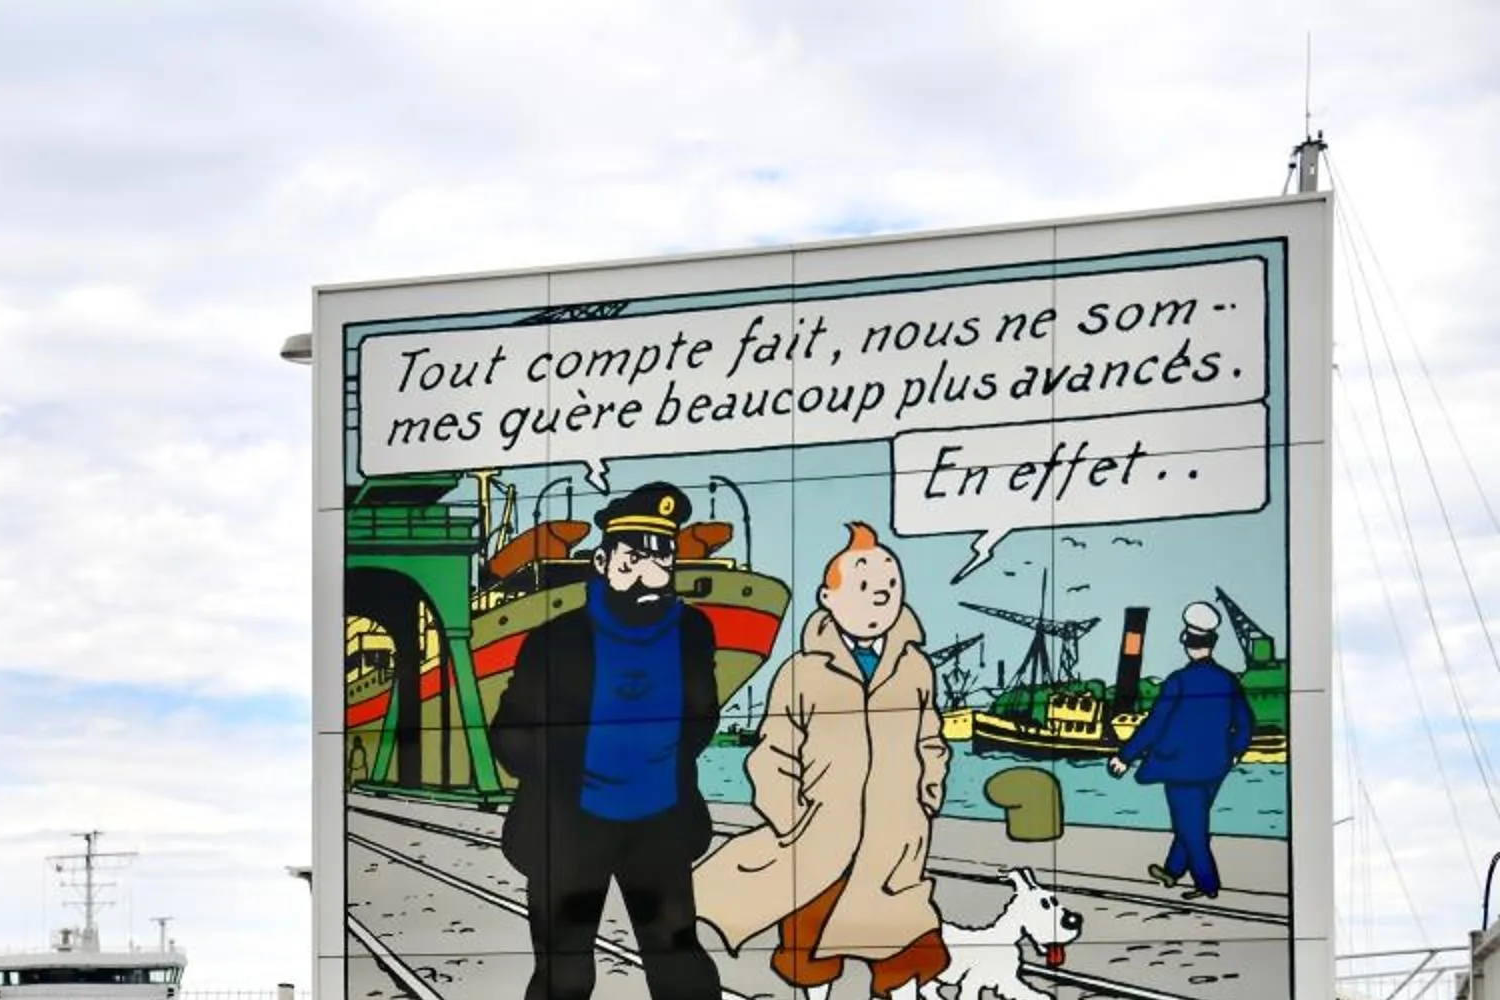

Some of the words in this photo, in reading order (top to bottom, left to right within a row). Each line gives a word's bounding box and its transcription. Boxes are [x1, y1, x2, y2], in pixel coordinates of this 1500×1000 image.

[398, 345, 507, 393] Tout
[526, 331, 714, 385] compte
[726, 315, 841, 378] fait,
[861, 316, 981, 354] nous
[995, 308, 1057, 343] ne
[387, 411, 483, 446] mes
[499, 388, 643, 451] guère
[655, 380, 885, 426] beaucoup
[895, 358, 998, 420] plus
[1009, 338, 1241, 400] avancés.
[924, 445, 989, 499] En
